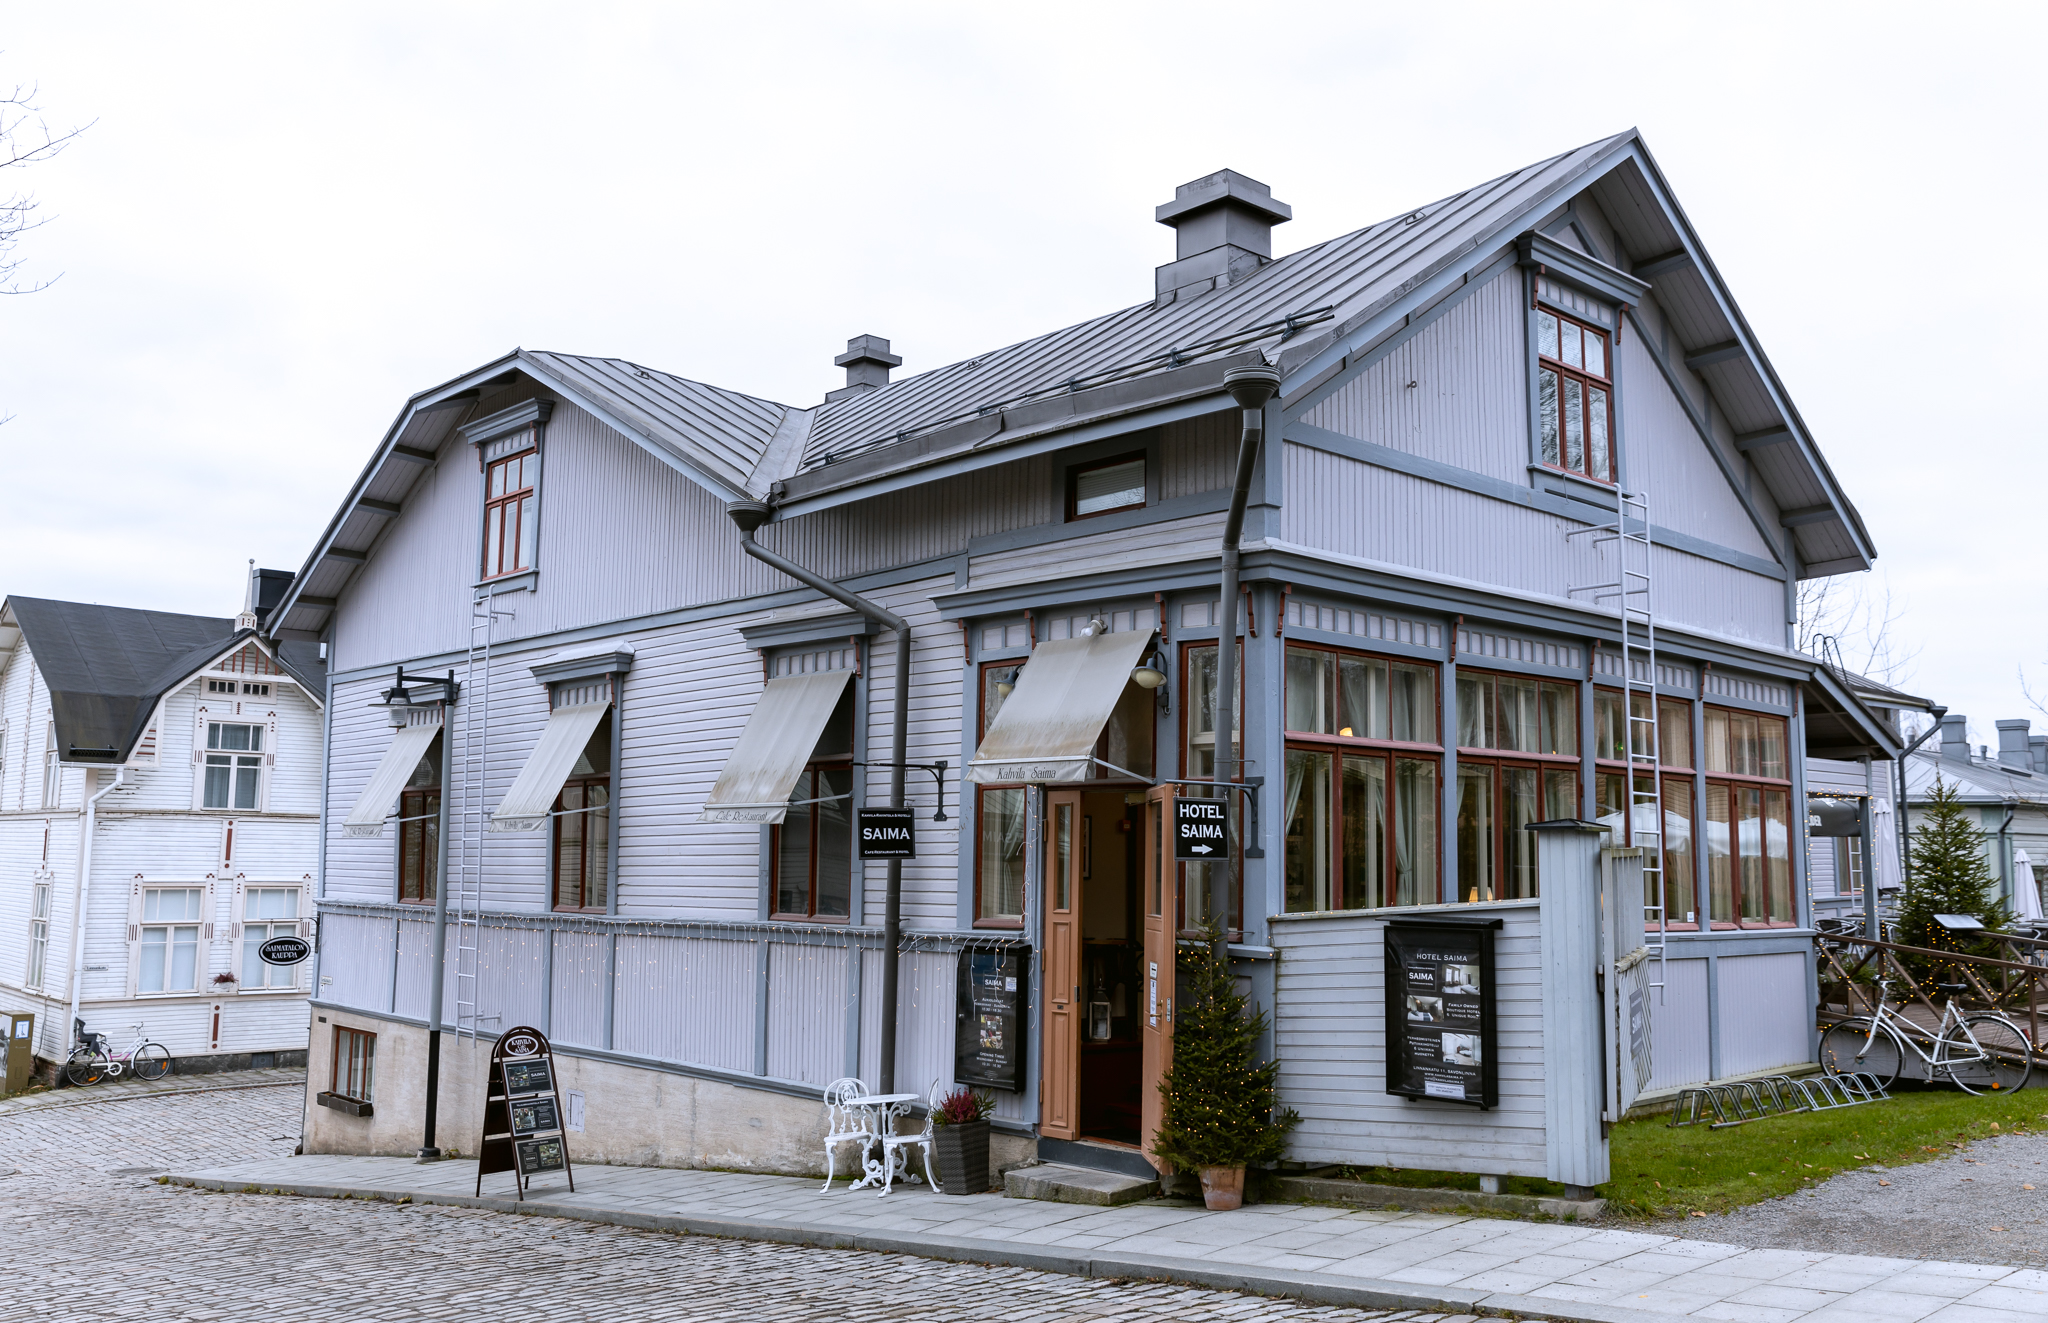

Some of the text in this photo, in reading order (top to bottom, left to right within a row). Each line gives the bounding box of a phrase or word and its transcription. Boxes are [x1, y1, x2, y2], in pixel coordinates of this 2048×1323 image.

[996, 766, 1056, 780] Kahvila Saima
[716, 810, 768, 821] Cafe Restaurant
[1180, 804, 1224, 819] HOTEL
[521, 820, 533, 829] Saima
[863, 828, 910, 840] SAIMA
[1181, 824, 1223, 838] SAIMA
[1409, 972, 1434, 980] SAIMA
